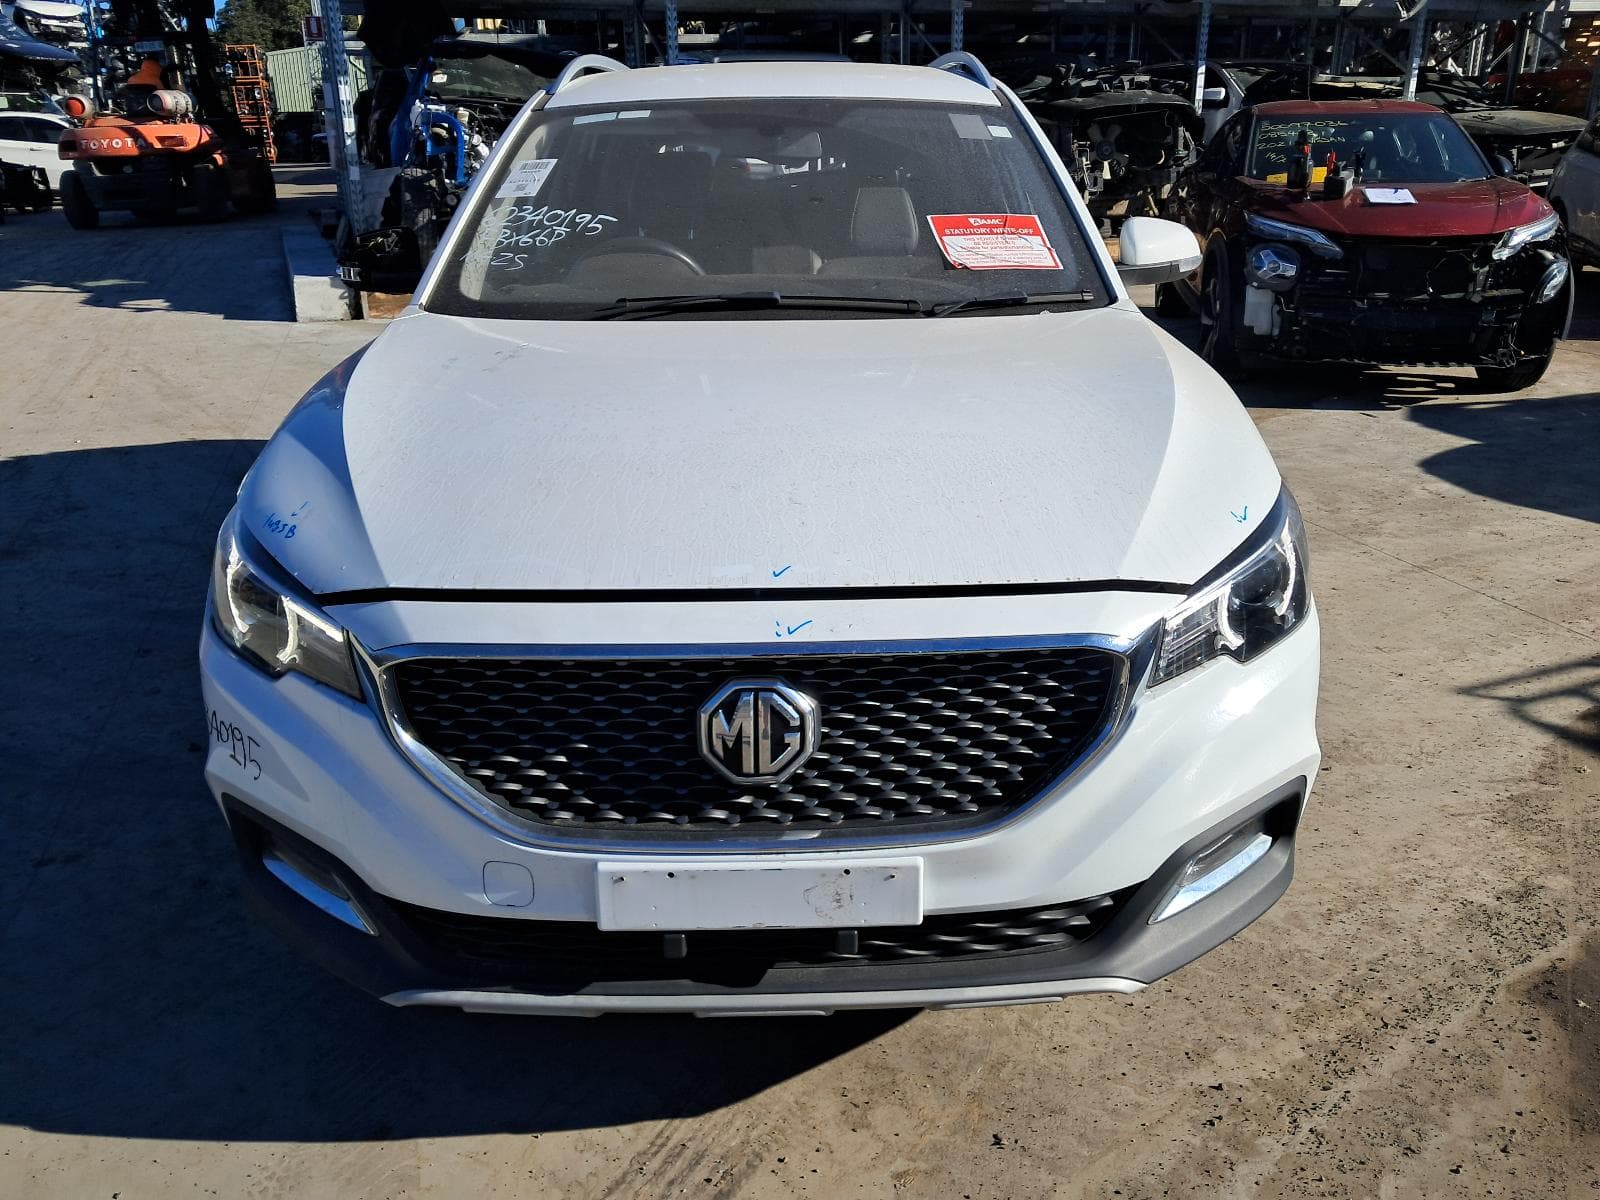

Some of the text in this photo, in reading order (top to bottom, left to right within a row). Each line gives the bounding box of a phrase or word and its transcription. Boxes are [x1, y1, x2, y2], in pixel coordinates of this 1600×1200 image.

[80, 137, 147, 149] TOYOTA
[944, 227, 991, 235] STATUTORY
[711, 691, 802, 774] MG
